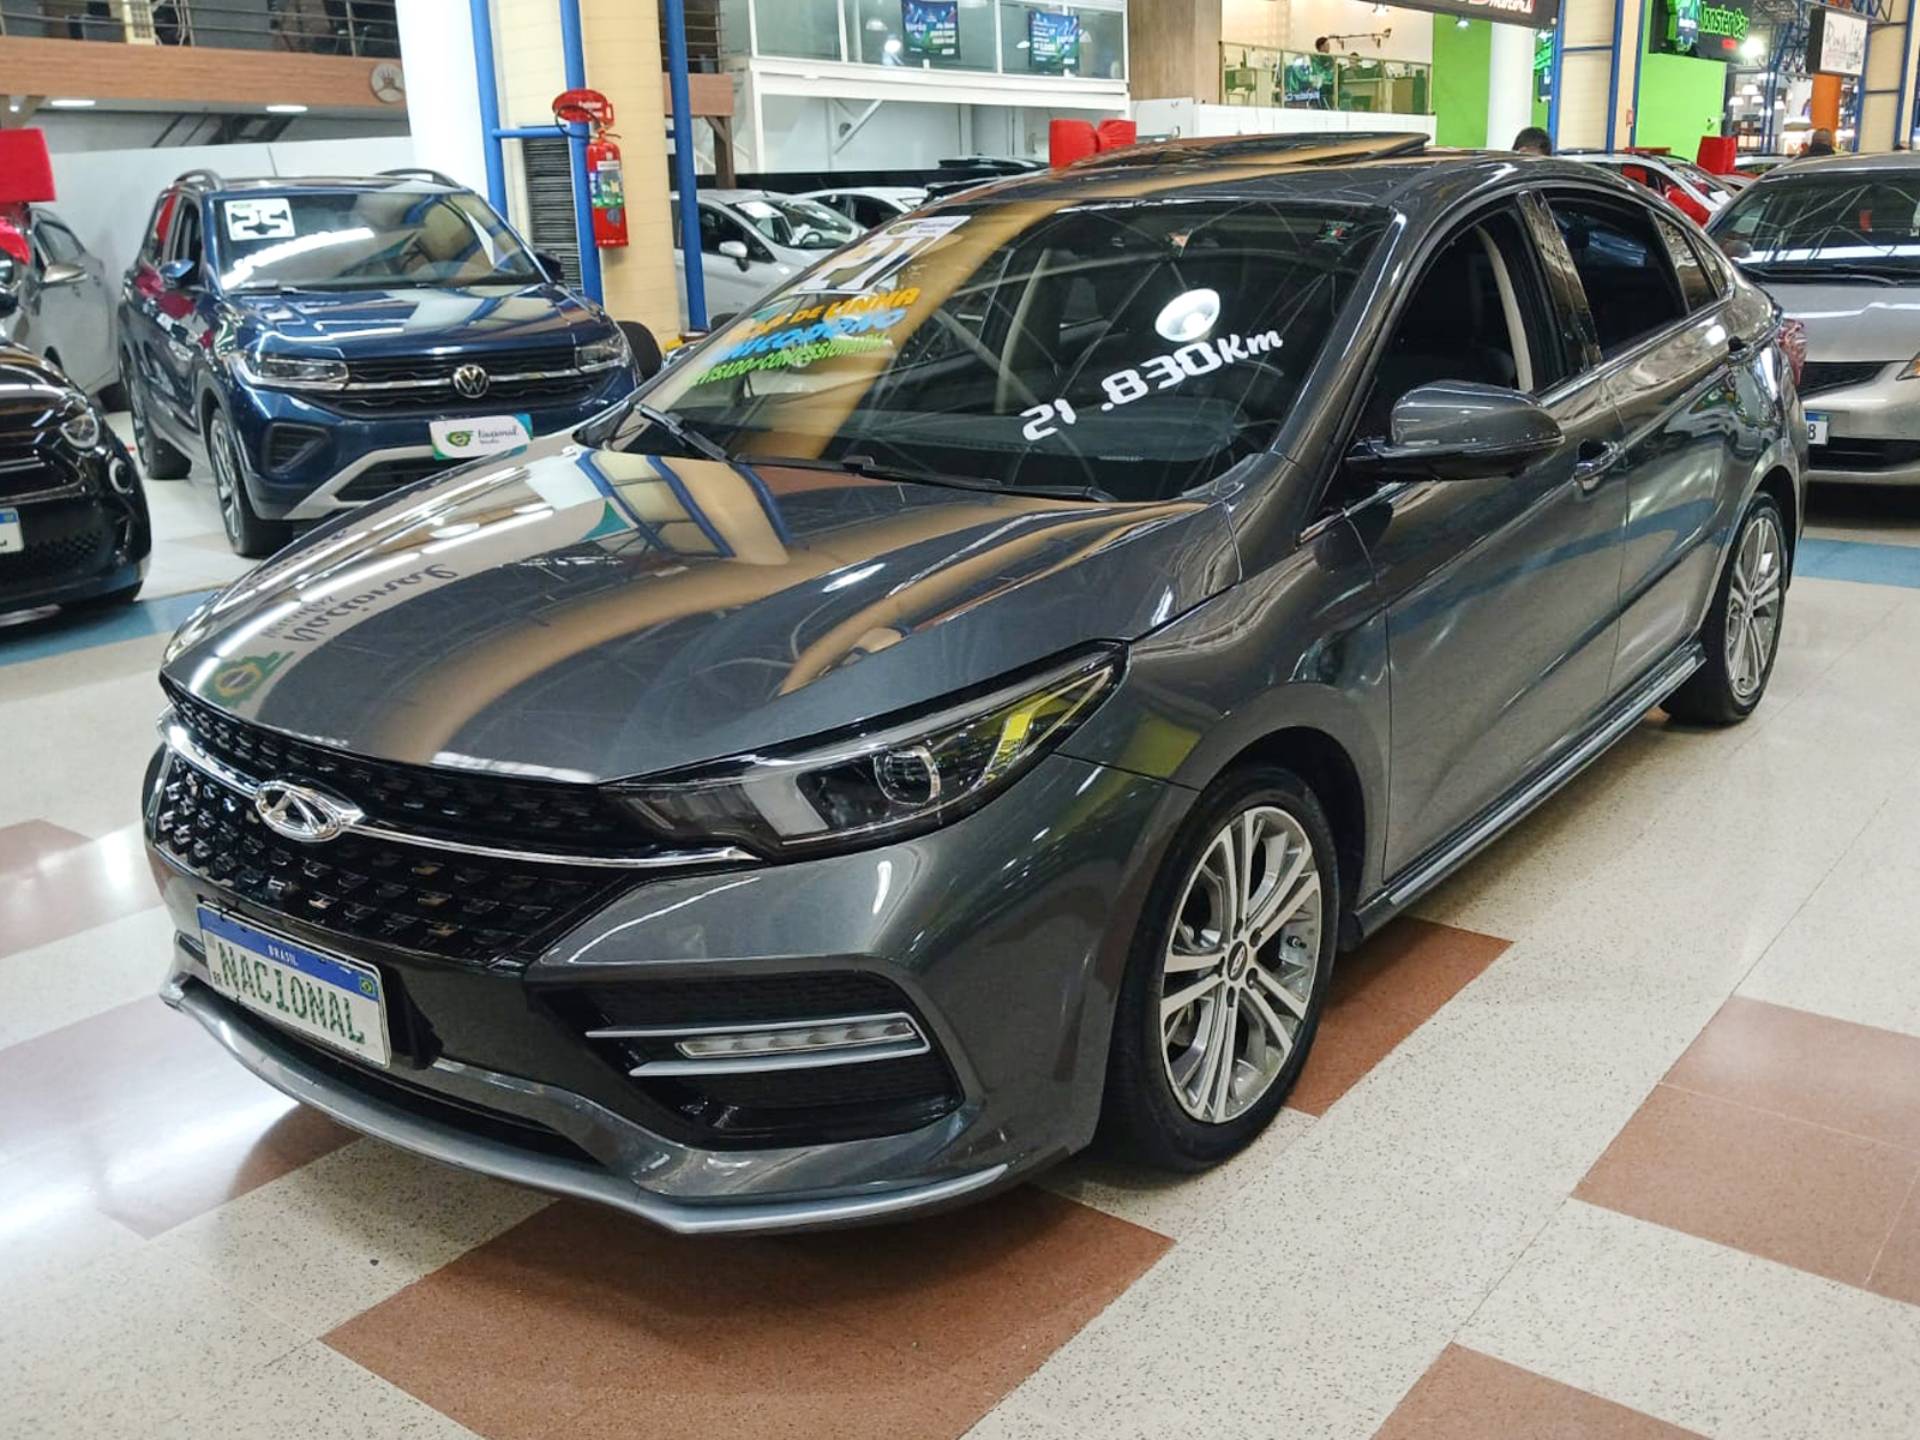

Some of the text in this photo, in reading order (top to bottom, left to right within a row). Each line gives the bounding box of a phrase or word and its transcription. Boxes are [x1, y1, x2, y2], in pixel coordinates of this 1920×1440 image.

[230, 208, 291, 236] 25
[268, 944, 299, 968] BRASIL
[218, 941, 366, 1046] NACIONAL
